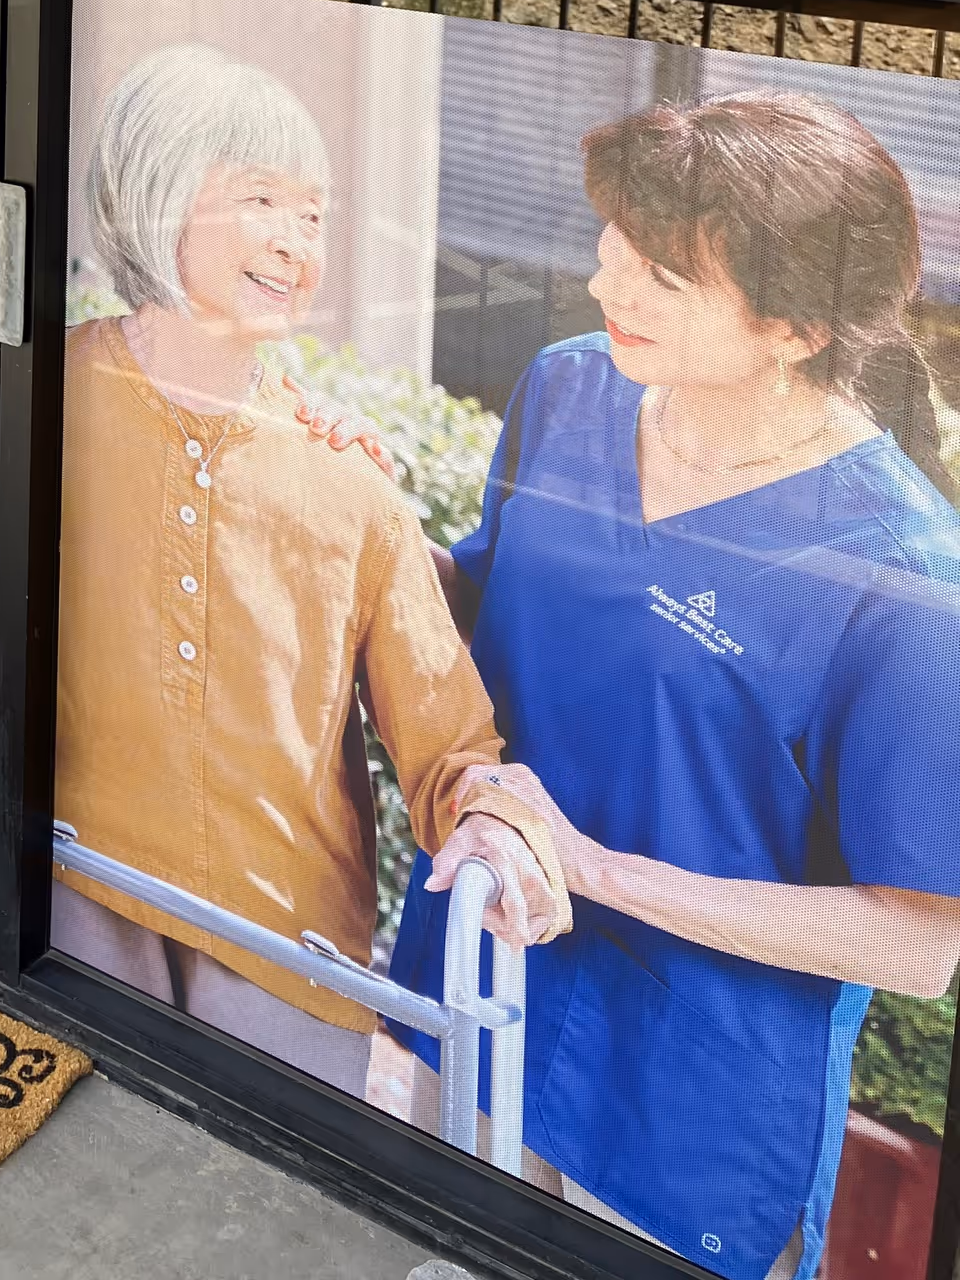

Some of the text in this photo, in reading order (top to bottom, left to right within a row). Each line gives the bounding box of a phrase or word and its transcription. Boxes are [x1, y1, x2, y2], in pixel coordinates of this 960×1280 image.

[646, 584, 744, 655] Always Best Care
[650, 603, 680, 623] senior
